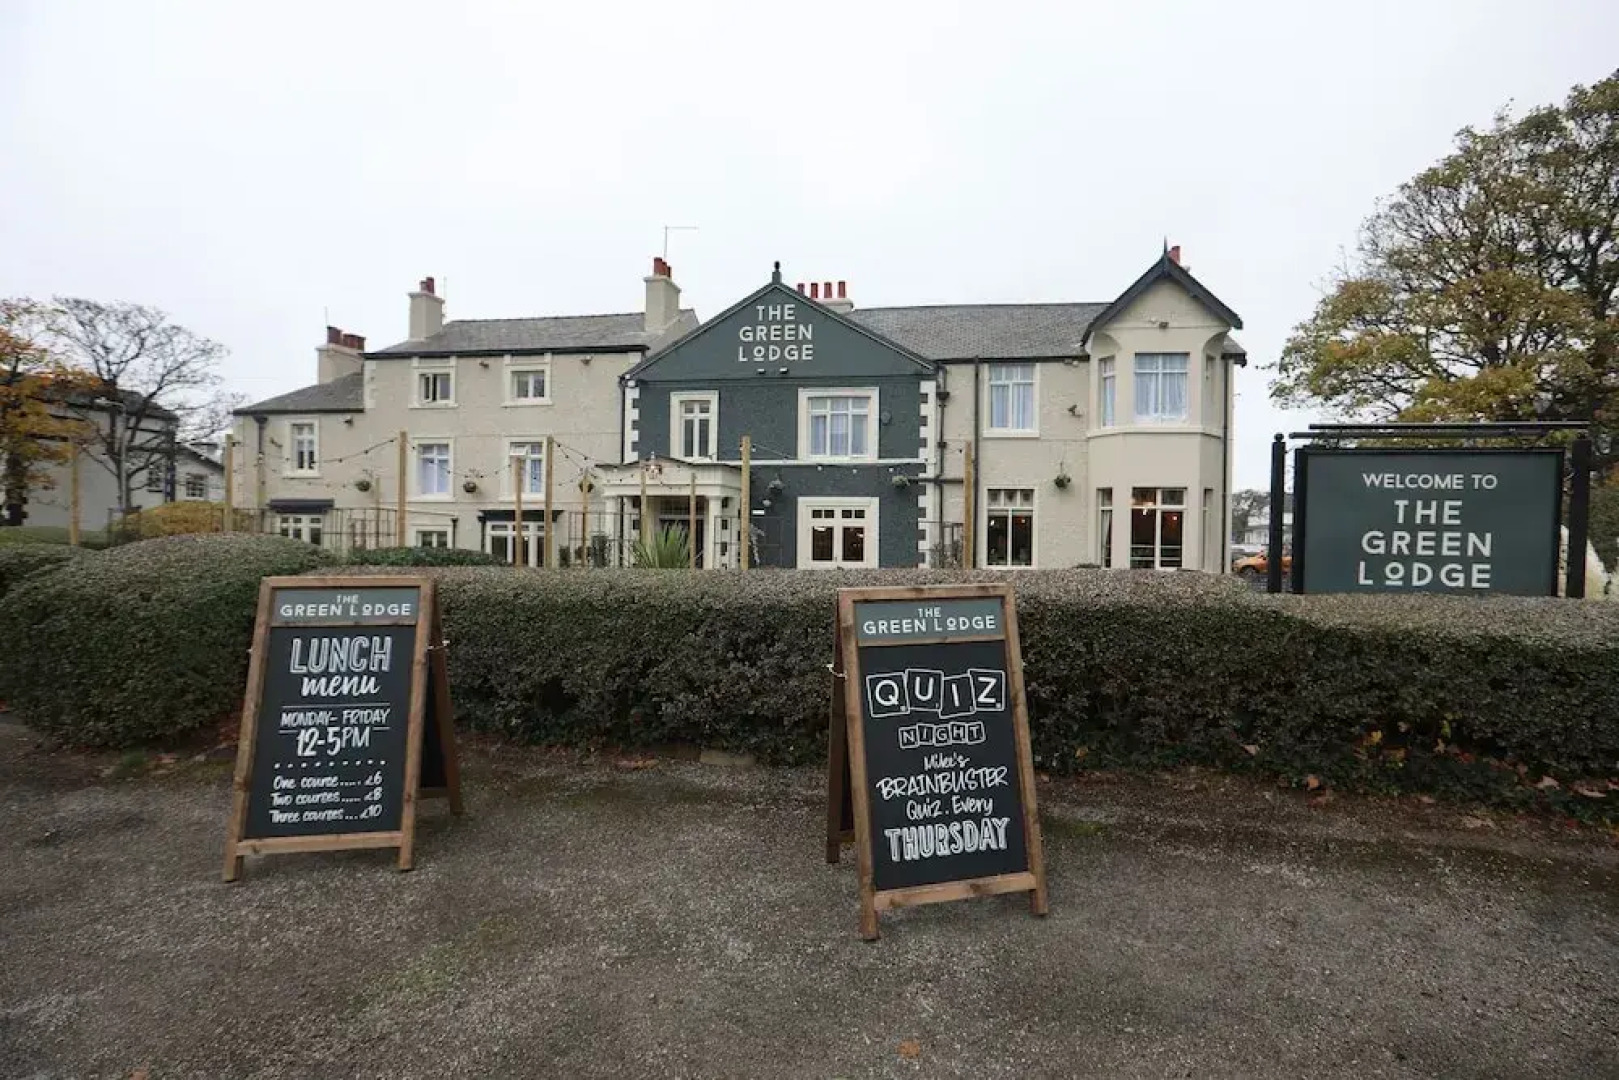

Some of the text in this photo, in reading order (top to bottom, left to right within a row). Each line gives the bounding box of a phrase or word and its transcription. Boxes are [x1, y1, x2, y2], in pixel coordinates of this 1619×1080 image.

[756, 303, 796, 321] THE
[739, 324, 812, 342] GREEN
[738, 344, 813, 361] LODGE
[1362, 473, 1498, 490] WELCOME TO
[1394, 500, 1463, 525] THE
[1361, 530, 1493, 558] GREEN
[1358, 561, 1493, 589] LODGE
[336, 594, 360, 605] THE
[279, 603, 412, 617] GREEN LODGE
[917, 606, 942, 618] THE
[862, 614, 996, 635] GREEN LODGE
[289, 635, 393, 674] LUNCH
[300, 674, 381, 697] menu
[873, 675, 998, 708] QUIZ
[342, 708, 391, 725] FRIDAY
[901, 725, 981, 744] NIGHT
[273, 775, 297, 791] One
[875, 766, 1008, 800] BRAINBUSTER
[269, 791, 293, 807] Two
[951, 795, 993, 817] Every
[268, 809, 300, 824] Three
[883, 817, 1011, 862] THURSDAY
